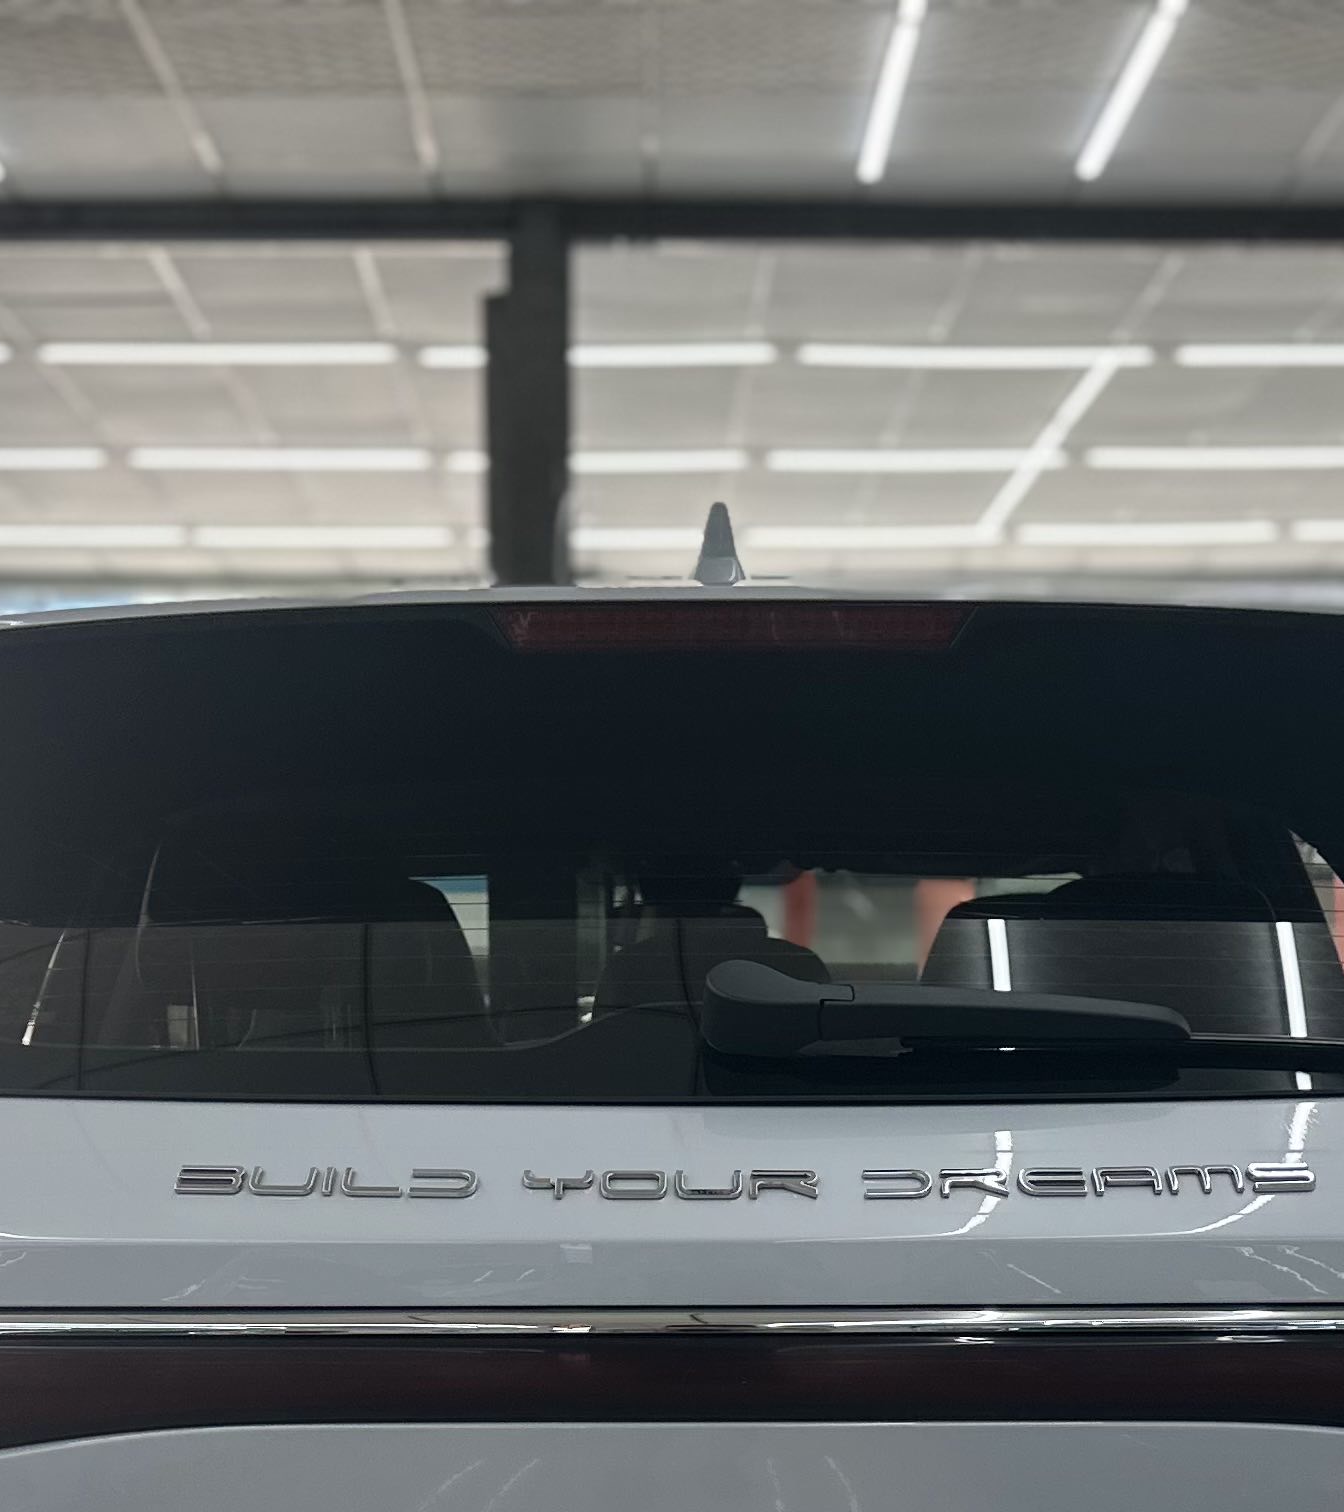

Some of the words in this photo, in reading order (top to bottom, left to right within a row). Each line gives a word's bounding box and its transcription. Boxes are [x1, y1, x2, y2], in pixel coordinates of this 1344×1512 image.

[174, 1164, 478, 1200] BUILD
[523, 1167, 820, 1201] YOUR
[862, 1160, 1317, 1199] DREAMS
